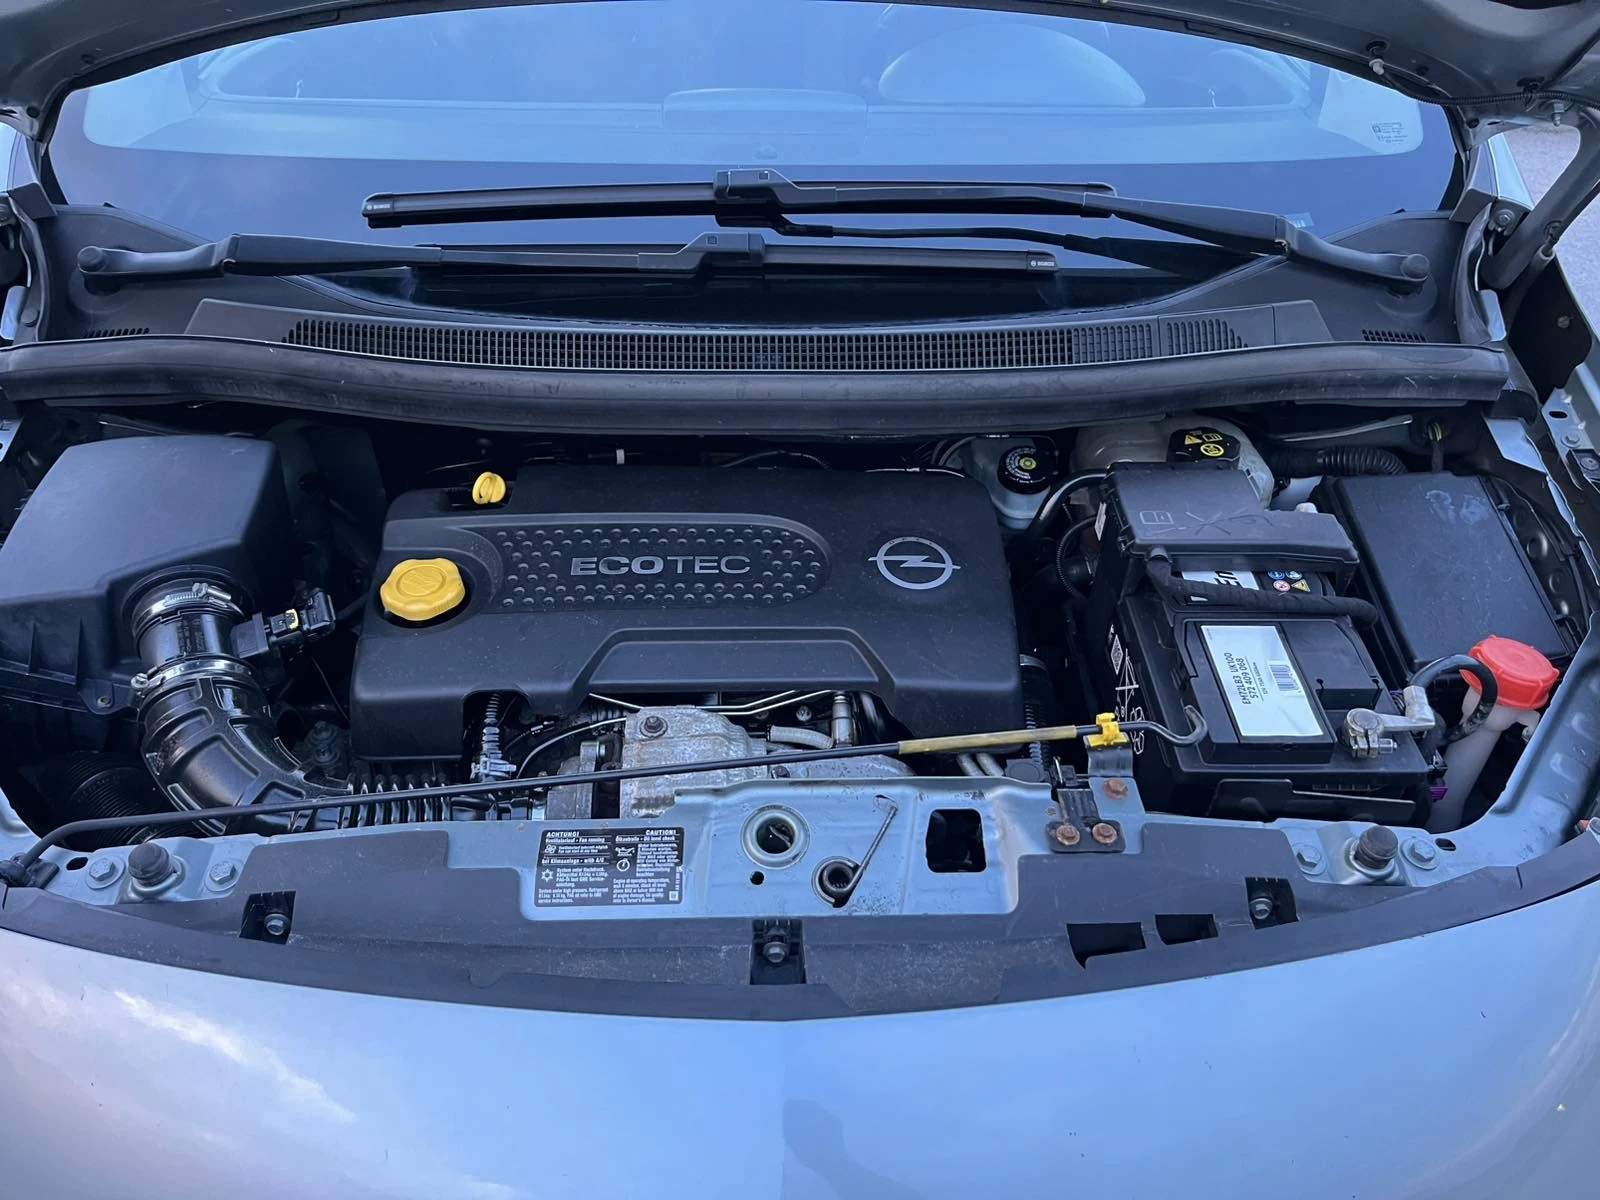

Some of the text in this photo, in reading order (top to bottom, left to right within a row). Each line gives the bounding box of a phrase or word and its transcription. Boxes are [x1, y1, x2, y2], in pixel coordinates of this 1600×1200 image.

[570, 556, 751, 576] ECOTEC
[1224, 652, 1238, 673] UK100
[1235, 658, 1247, 671] 068
[1241, 672, 1252, 685] 409
[1246, 686, 1259, 699] 572
